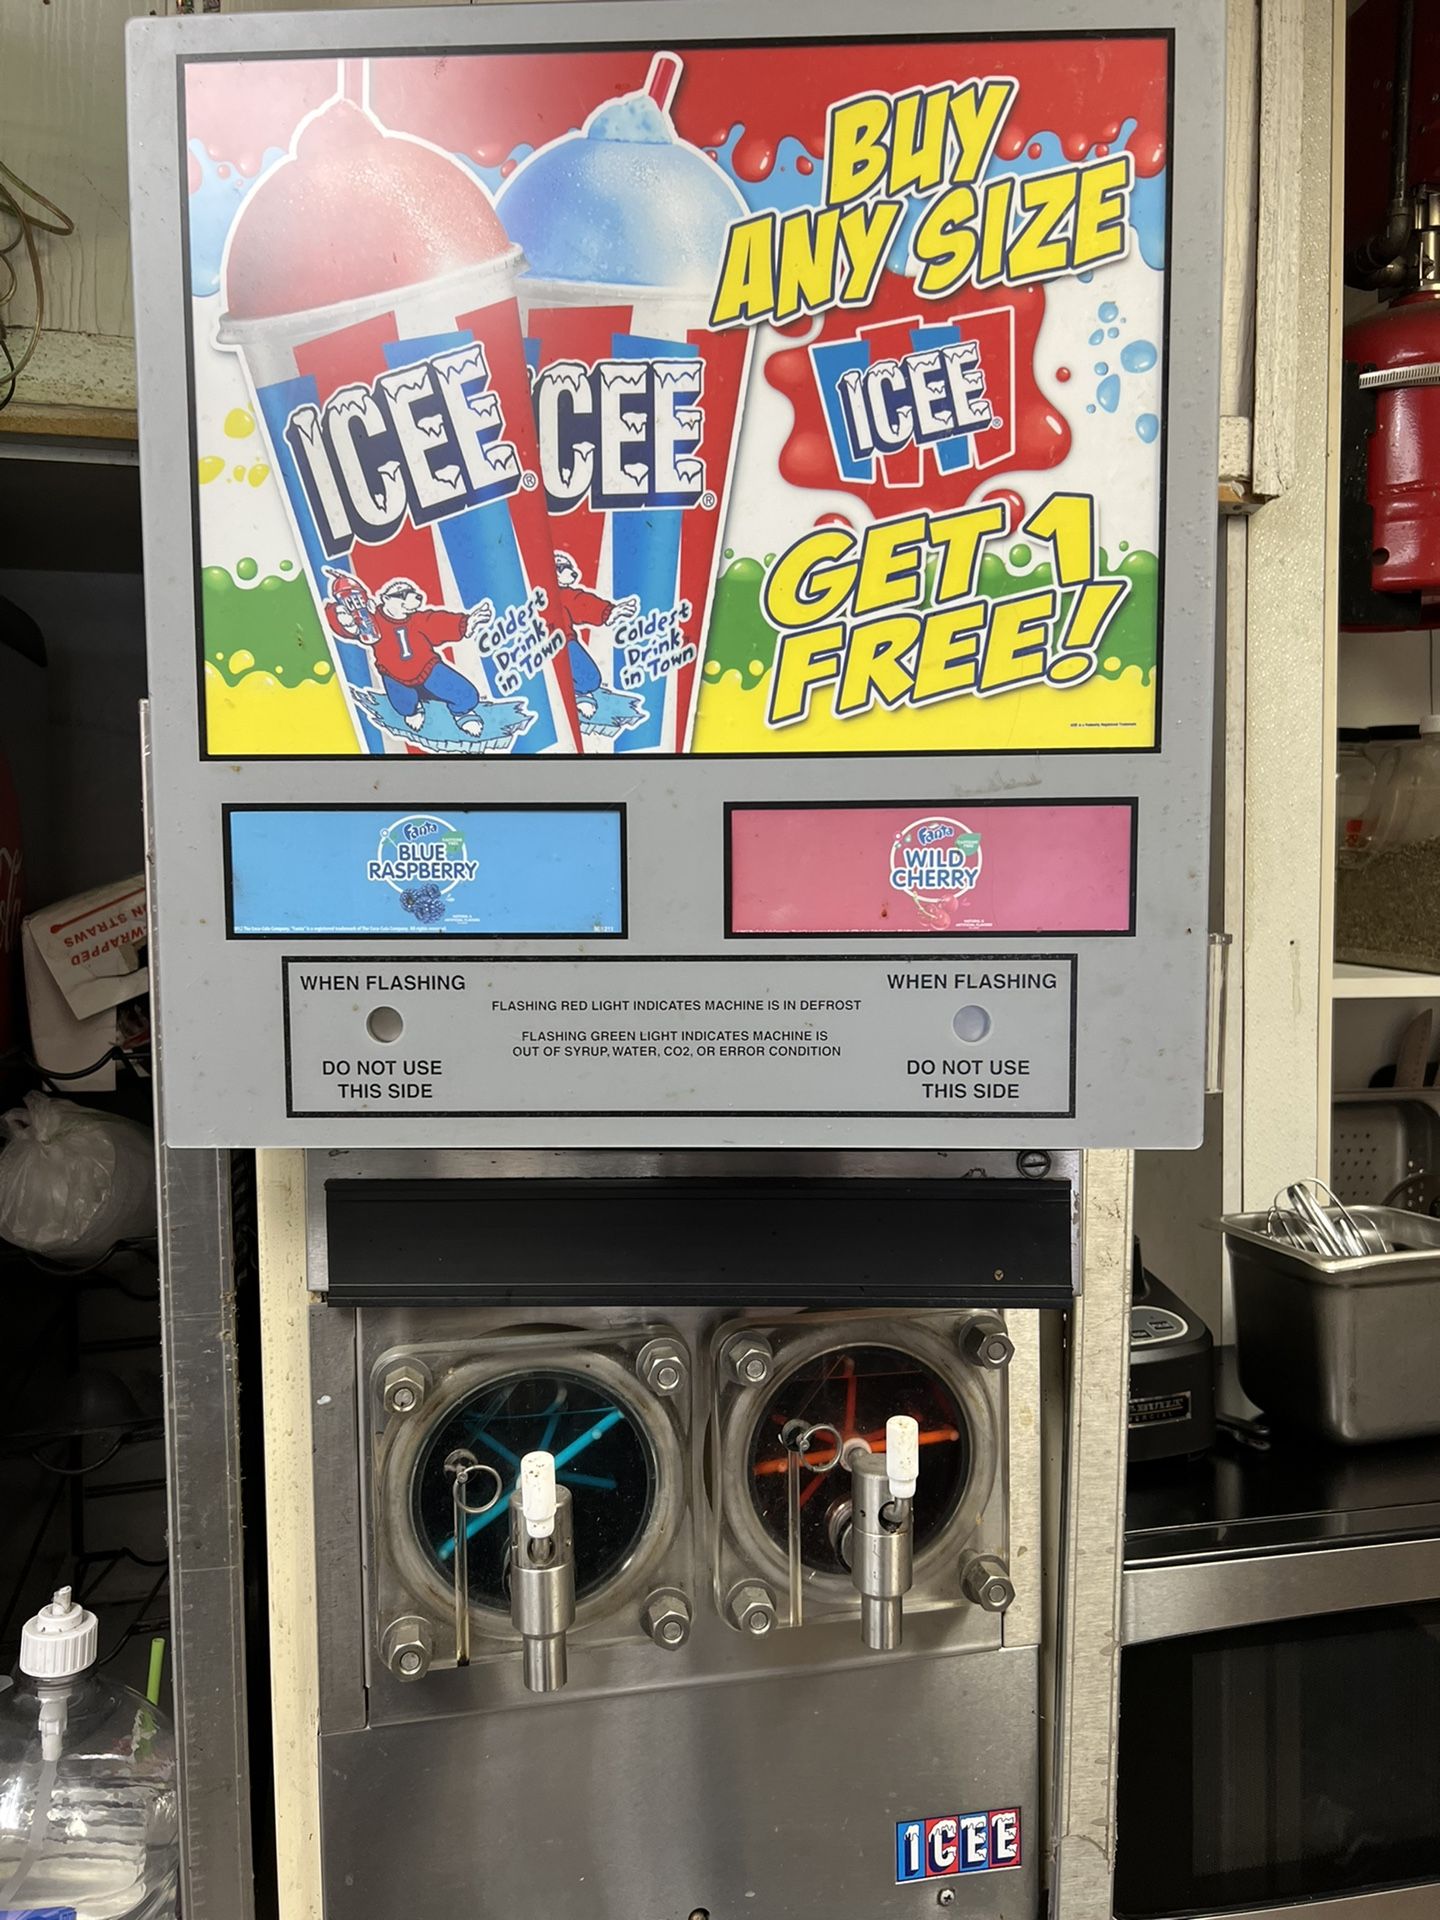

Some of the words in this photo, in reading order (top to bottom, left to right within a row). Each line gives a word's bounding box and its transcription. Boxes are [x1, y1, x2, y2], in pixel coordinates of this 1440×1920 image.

[829, 81, 1014, 205] BUY
[710, 200, 902, 325] ANY
[915, 156, 1131, 294] SIZE
[838, 342, 991, 458] ICEE
[287, 343, 521, 556] ICEE
[528, 360, 706, 512] CEE
[765, 503, 1005, 627] GET
[1023, 492, 1093, 587] 1
[478, 591, 545, 652] Coldest
[615, 603, 690, 644] Coldest
[496, 620, 547, 670] Drink
[628, 629, 680, 665] Drink
[768, 581, 1128, 724] FREE!
[498, 673, 519, 691] in
[520, 633, 563, 673] Town
[623, 671, 642, 686] in
[650, 648, 694, 677] Town
[404, 821, 438, 841] Fanta
[918, 824, 954, 845] Fanta
[398, 844, 446, 862] BLUE
[904, 849, 965, 868] WILD
[368, 861, 478, 880] RASPBERRY
[891, 868, 979, 888] CHERRY
[63, 913, 128, 948] STRAWS
[299, 975, 359, 991] WHEN
[366, 974, 466, 991] FLASHING
[886, 973, 947, 990] WHEN
[954, 973, 1057, 990] FLASHING
[491, 1000, 557, 1012] FLASHING
[561, 1000, 588, 1011] RED
[591, 1000, 630, 1011] LIGHT
[633, 1000, 701, 1011] INDICATES
[704, 1000, 764, 1011] MACHINE
[767, 999, 780, 1011] IS
[783, 1000, 796, 1011] IN
[800, 999, 862, 1011] DEFROST
[522, 1030, 587, 1042] FLASHING
[590, 1030, 636, 1042] GREEN
[639, 1030, 678, 1042] LIGHT
[681, 1030, 750, 1042] INDICATES
[753, 1030, 812, 1042] MACHINE
[816, 1030, 828, 1042] IS
[512, 1046, 540, 1057] OUT
[543, 1046, 561, 1057] OF
[564, 1046, 610, 1058] SYRUP,
[612, 1046, 661, 1058] WATER,
[663, 1045, 693, 1058] CO2,
[696, 1045, 716, 1057] OR
[719, 1045, 765, 1057] ERROR
[768, 1045, 841, 1057] CONDITION
[322, 1060, 351, 1076] DO
[357, 1060, 397, 1076] NOT
[403, 1059, 443, 1076] USE
[907, 1059, 936, 1075] DO
[942, 1059, 984, 1075] NOT
[990, 1059, 1030, 1076] USE
[337, 1083, 382, 1099] THIS
[388, 1083, 433, 1099] SIDE
[921, 1083, 967, 1099] THIS
[973, 1083, 1020, 1099] SIDE
[903, 1812, 1018, 1877] ICEE
